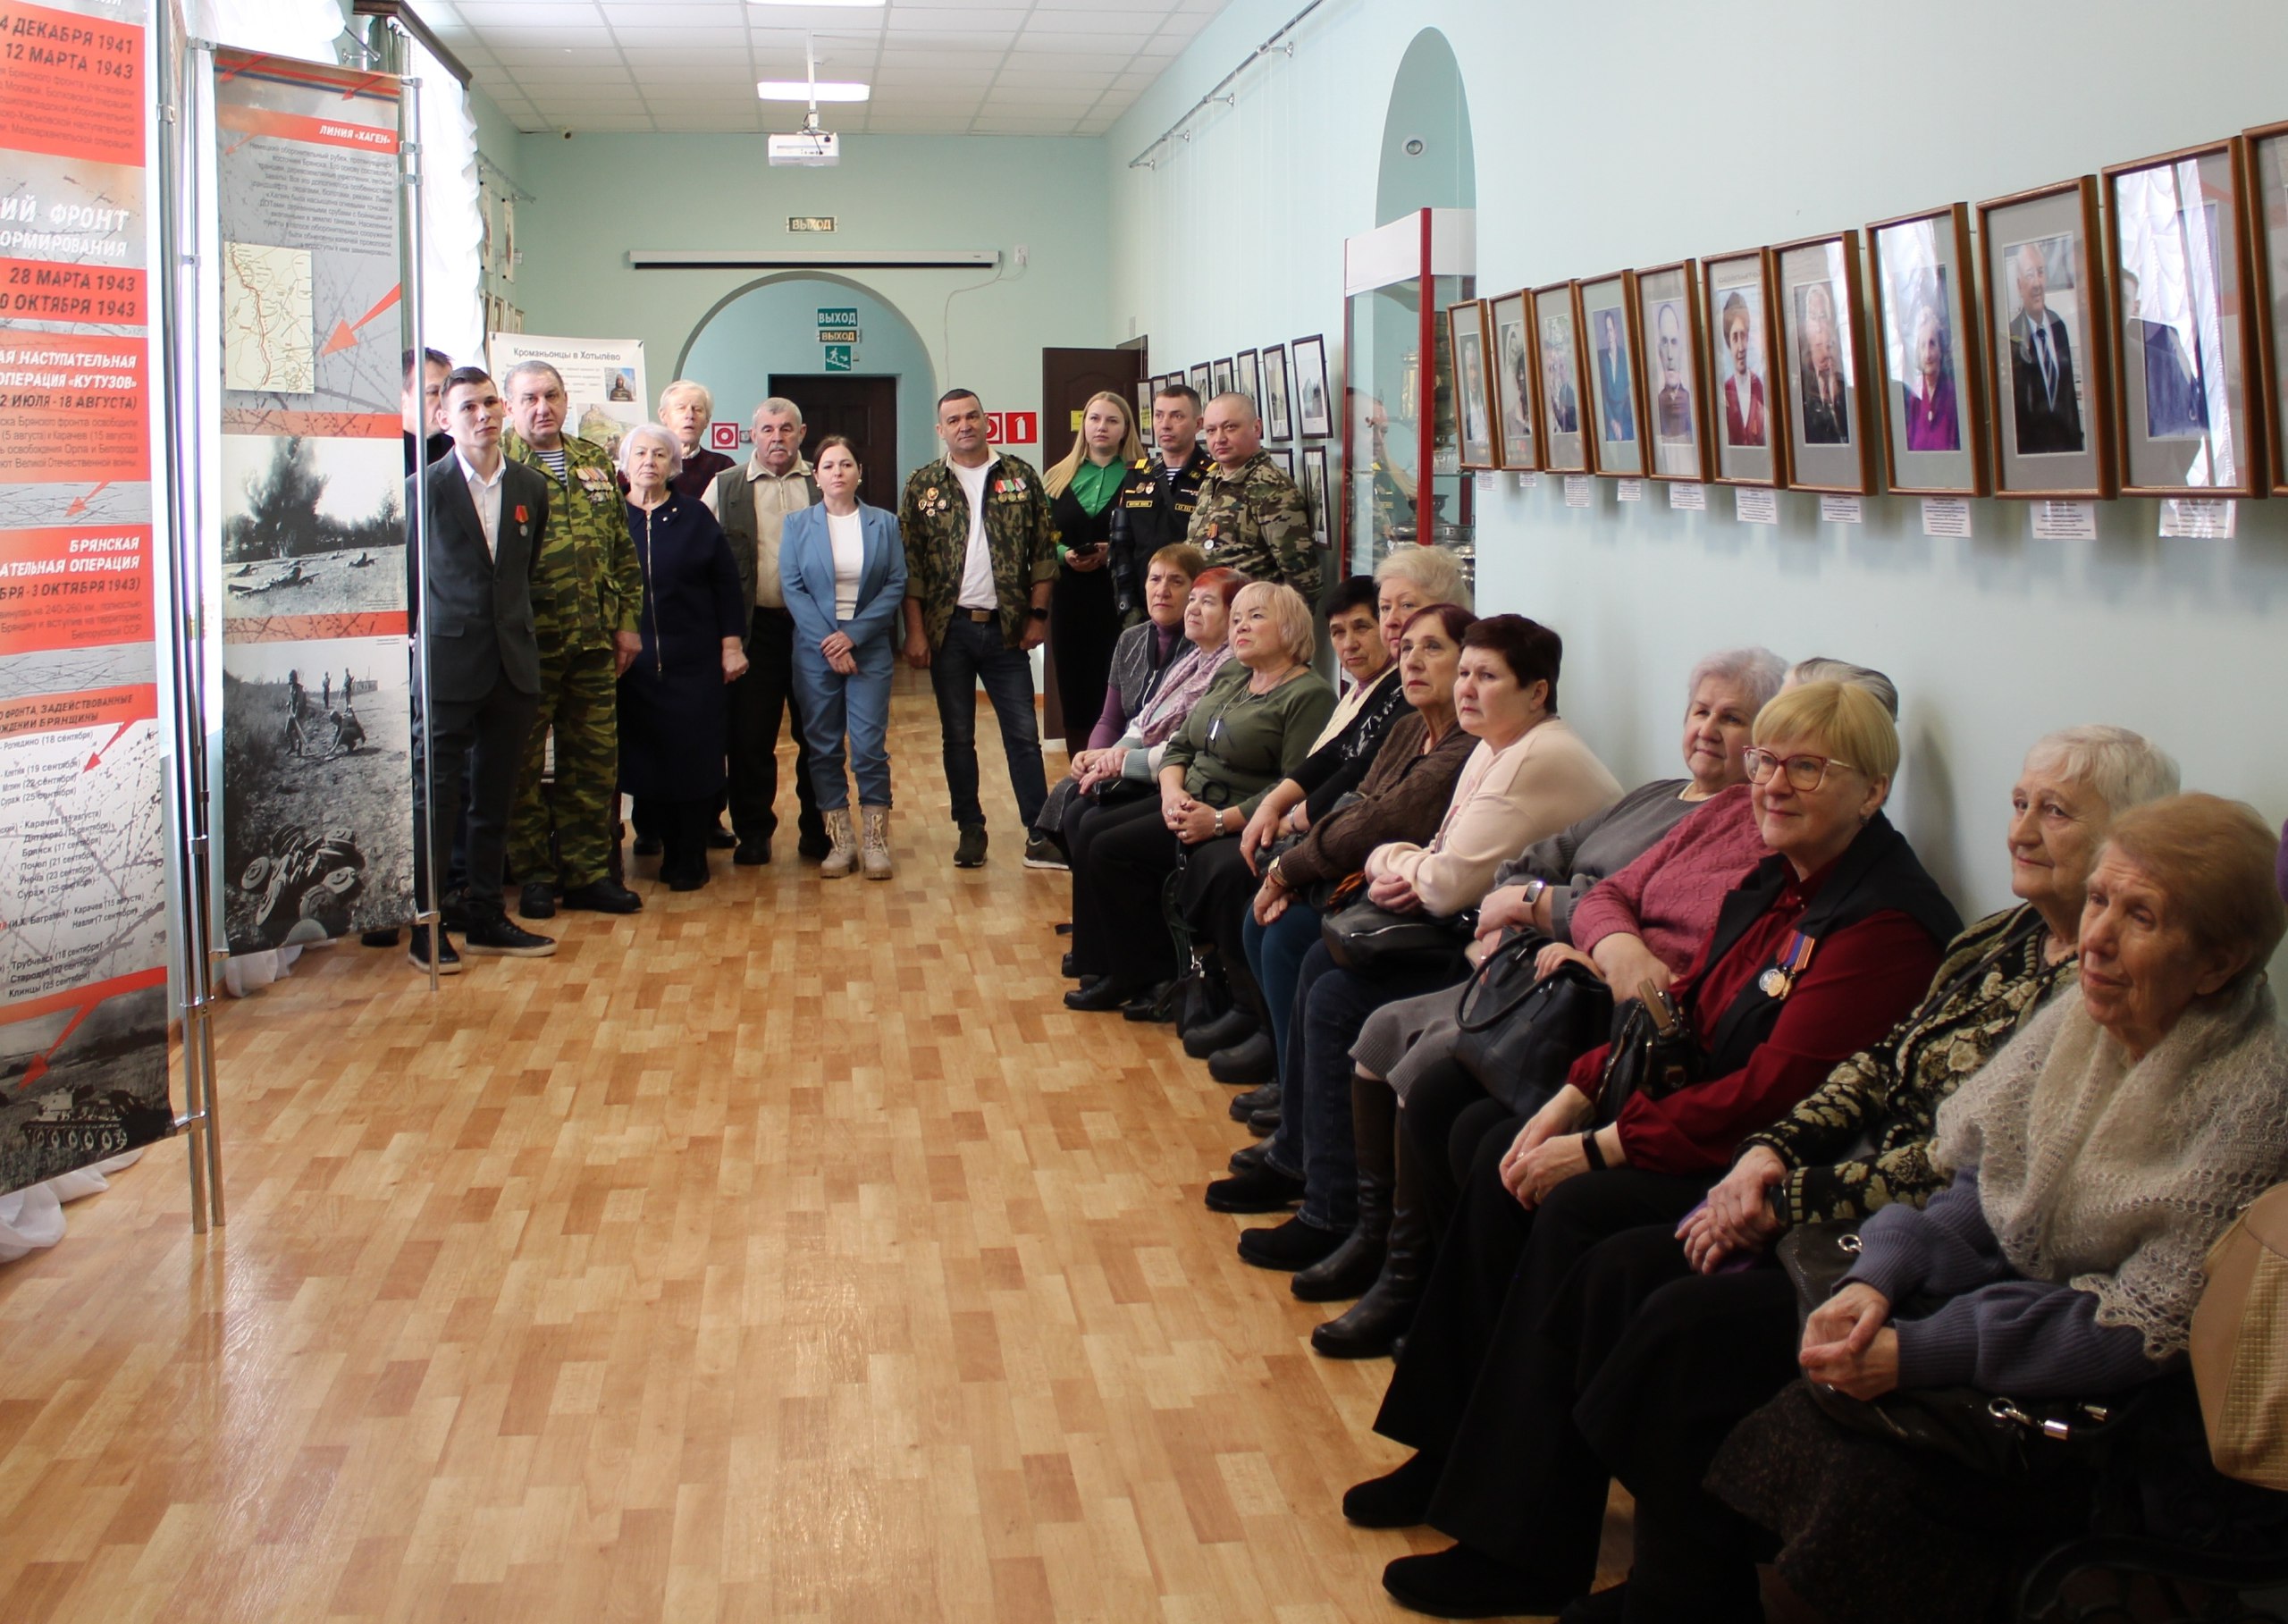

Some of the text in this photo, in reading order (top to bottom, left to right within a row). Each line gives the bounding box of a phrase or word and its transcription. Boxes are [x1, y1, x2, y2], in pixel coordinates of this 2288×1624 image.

[13, 18, 93, 46] ДЕКАБРЯ
[99, 34, 132, 54] 1941
[6, 43, 133, 80] 12 МАРТА 1943
[319, 125, 391, 144] ЛИНИЯ «ХАГЕН»
[0, 194, 130, 231] ИЙ ФРОНТ
[792, 219, 831, 231] ВЫХОД
[0, 231, 128, 257] ОРМИРОВАНИЯ
[9, 267, 135, 293] 28 МАРТА 1943
[14, 294, 91, 315] ОКТЯБРЯ
[98, 300, 135, 318] 1943
[819, 313, 857, 324] ВЫХОД
[821, 332, 854, 341] ВЫХОД
[17, 350, 137, 369] НАСТУПАТЕЛЬНАЯ
[514, 348, 571, 359] Кроманьонцы
[580, 350, 620, 361] Хотылёво
[68, 374, 137, 389] «КУТУЗОВ»
[12, 394, 51, 408] ИЮЛЯ
[59, 395, 72, 408] 18
[75, 396, 137, 411] АВГУСТА)
[69, 536, 140, 553] БРЯНСКАЯ
[0, 555, 140, 577] АТЕЛЬНАЯ ОПЕРАЦИЯ
[0, 577, 141, 600] БРЯ 3 ОКТЯБРЯ 1943)
[40, 694, 133, 714] ЗАДЕЙСТВОВАННЫЕ
[39, 712, 98, 728] БРЯНЩИНЫ
[25, 817, 59, 830] Карачев
[21, 846, 52, 858] Брянск
